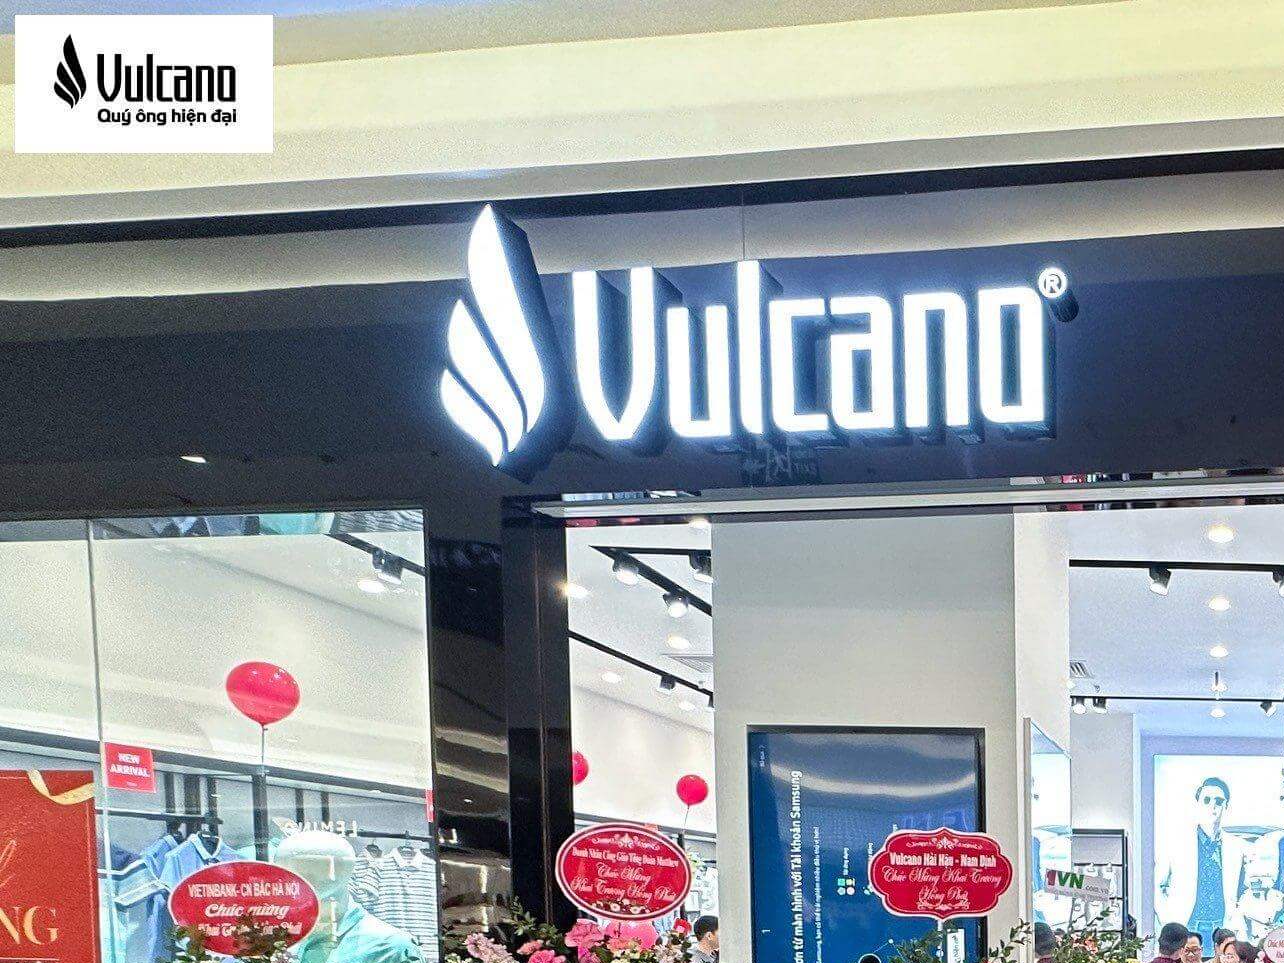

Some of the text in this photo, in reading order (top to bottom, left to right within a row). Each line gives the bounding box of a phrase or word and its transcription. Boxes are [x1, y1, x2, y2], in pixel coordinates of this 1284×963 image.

[789, 770, 802, 818] Samsung
[790, 820, 801, 853] khoản
[889, 851, 922, 866] Vulcano
[960, 854, 978, 867] Nam
[205, 903, 244, 918] Chúc
[790, 889, 802, 912] hình
